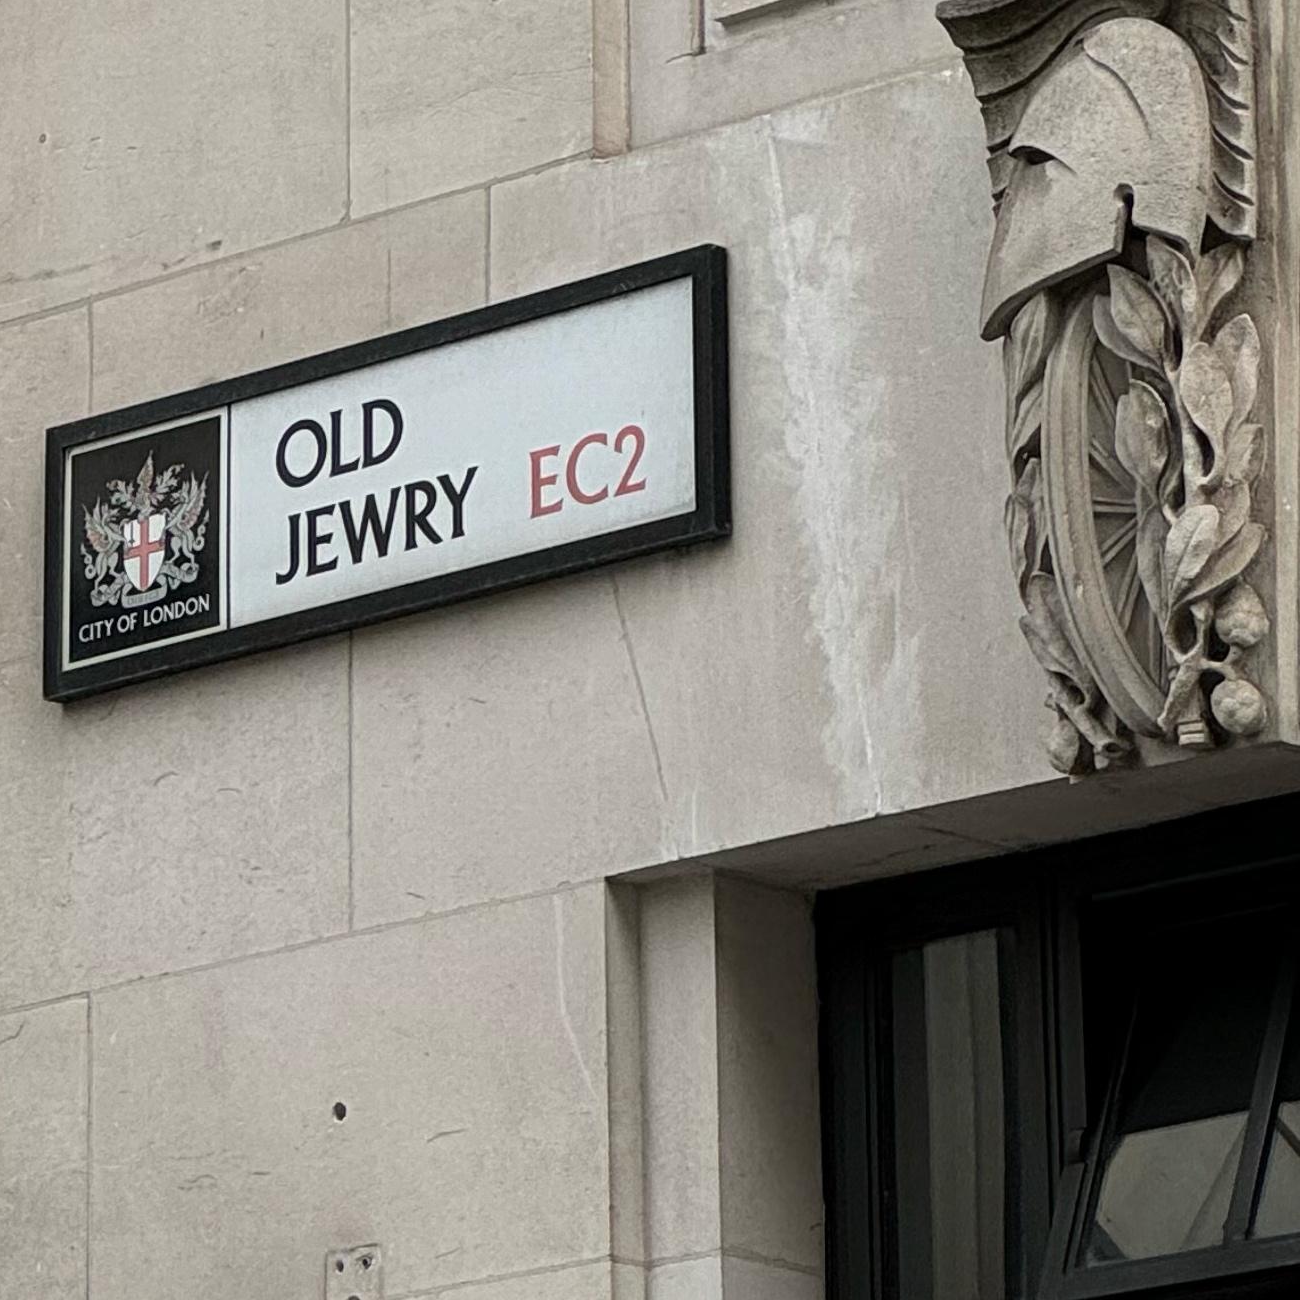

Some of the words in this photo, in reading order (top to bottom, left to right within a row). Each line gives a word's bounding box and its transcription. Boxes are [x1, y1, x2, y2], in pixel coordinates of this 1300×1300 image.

[275, 399, 404, 488] OLD
[275, 466, 479, 585] JEWRY
[528, 425, 647, 519] EC2
[78, 618, 113, 643] CITY
[117, 612, 138, 634] OF
[143, 594, 211, 628] LONDON
